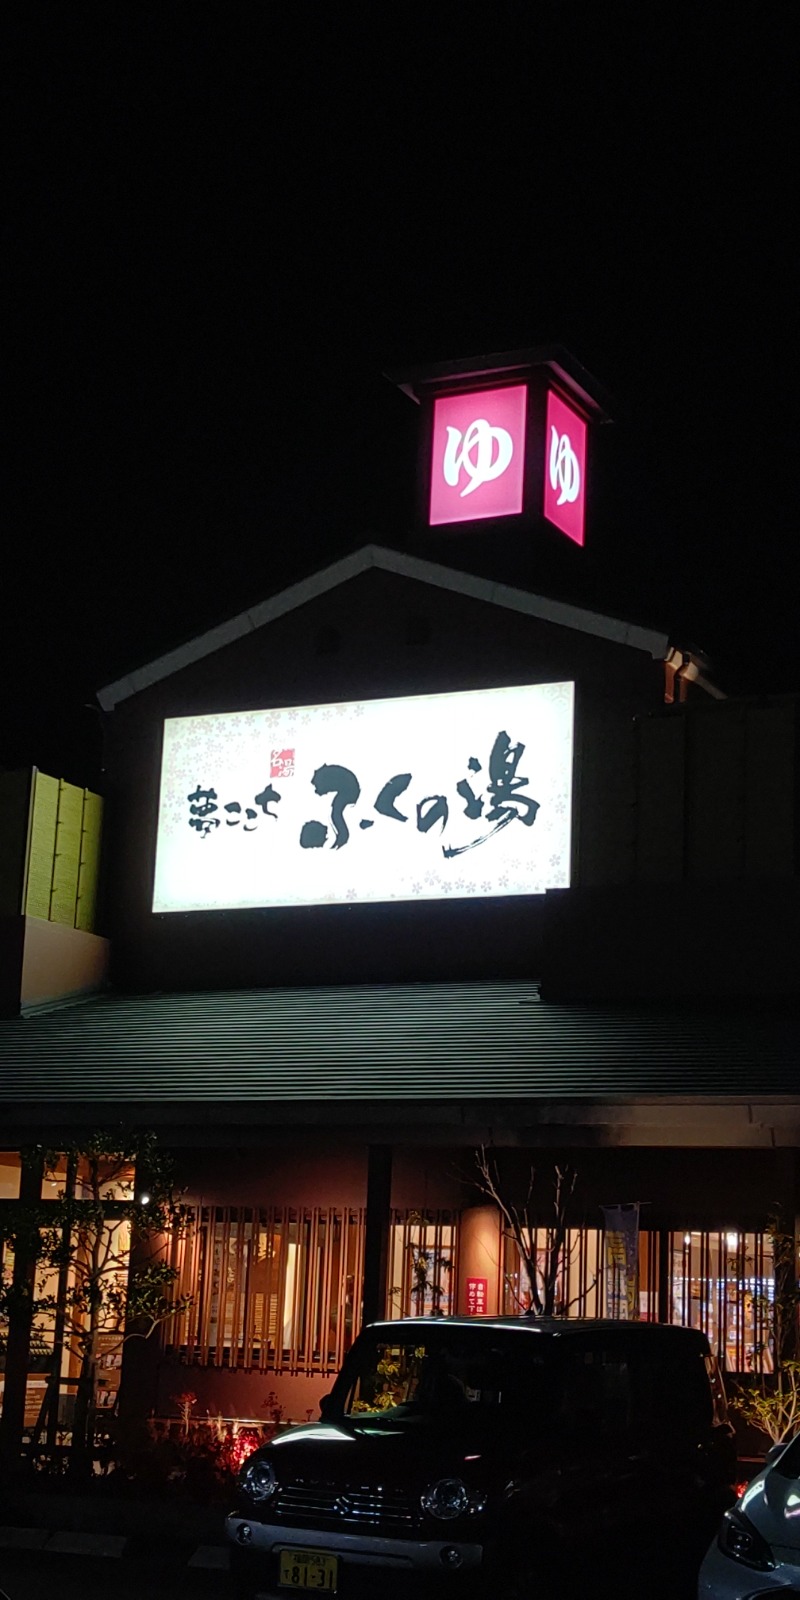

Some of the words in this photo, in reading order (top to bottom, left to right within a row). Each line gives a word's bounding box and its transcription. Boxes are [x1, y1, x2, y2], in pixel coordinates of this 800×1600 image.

[443, 418, 514, 498] ゆ
[549, 425, 580, 506] ゆ
[187, 783, 281, 839] 夢ここち
[300, 731, 540, 859] ふくの湯
[468, 1283, 476, 1315] 停めて下
[476, 1283, 484, 1314] 自動車は
